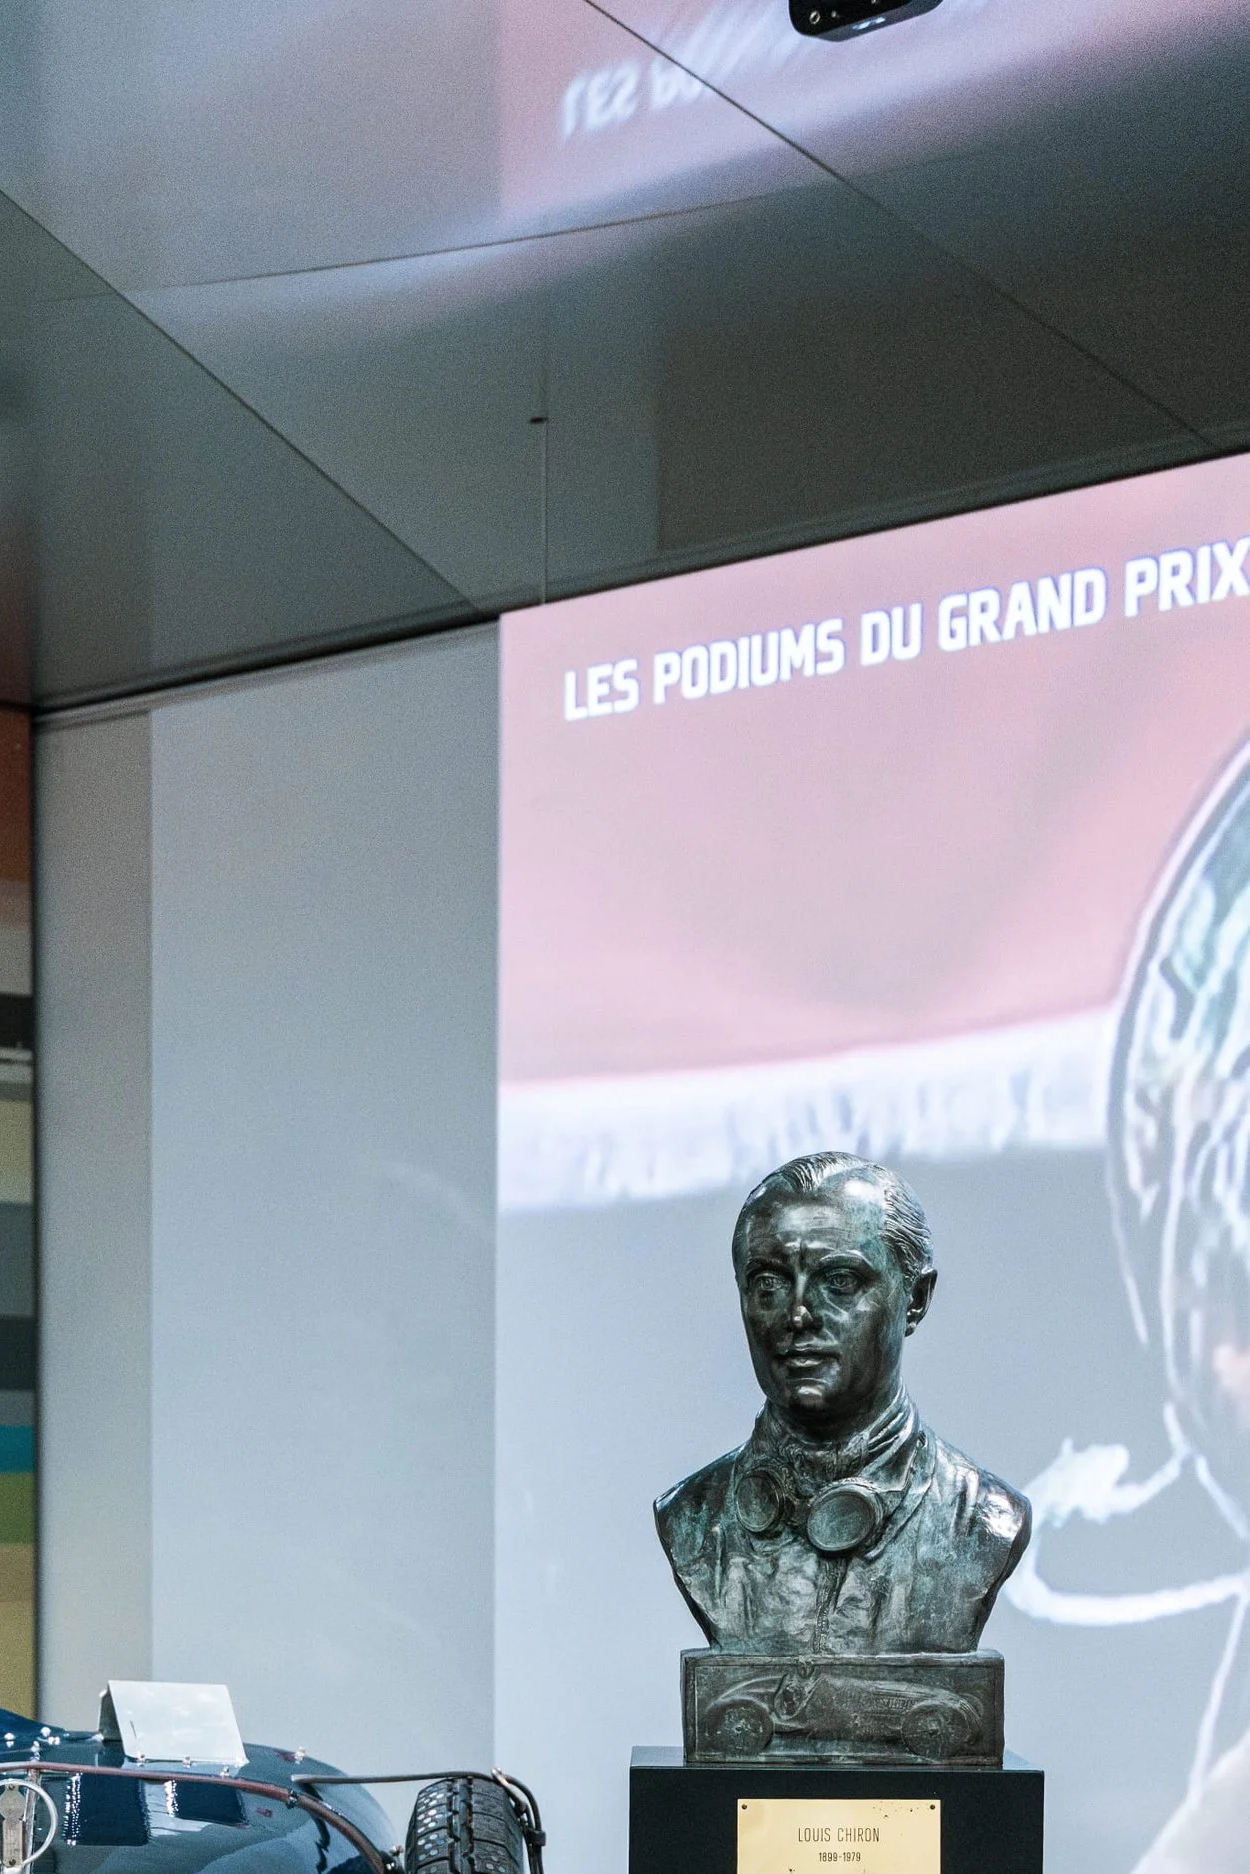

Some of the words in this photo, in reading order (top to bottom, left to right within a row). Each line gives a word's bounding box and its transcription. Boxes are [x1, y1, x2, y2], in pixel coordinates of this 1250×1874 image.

[564, 658, 639, 721] LES
[653, 618, 845, 704] PODIUMS
[860, 602, 921, 667] DU
[938, 566, 1107, 651] GRAND
[1124, 535, 1250, 618] PRIX
[798, 1827, 831, 1842] LOUIS
[837, 1827, 880, 1842] CHIRON
[819, 1851, 861, 1862] 1899-1979
